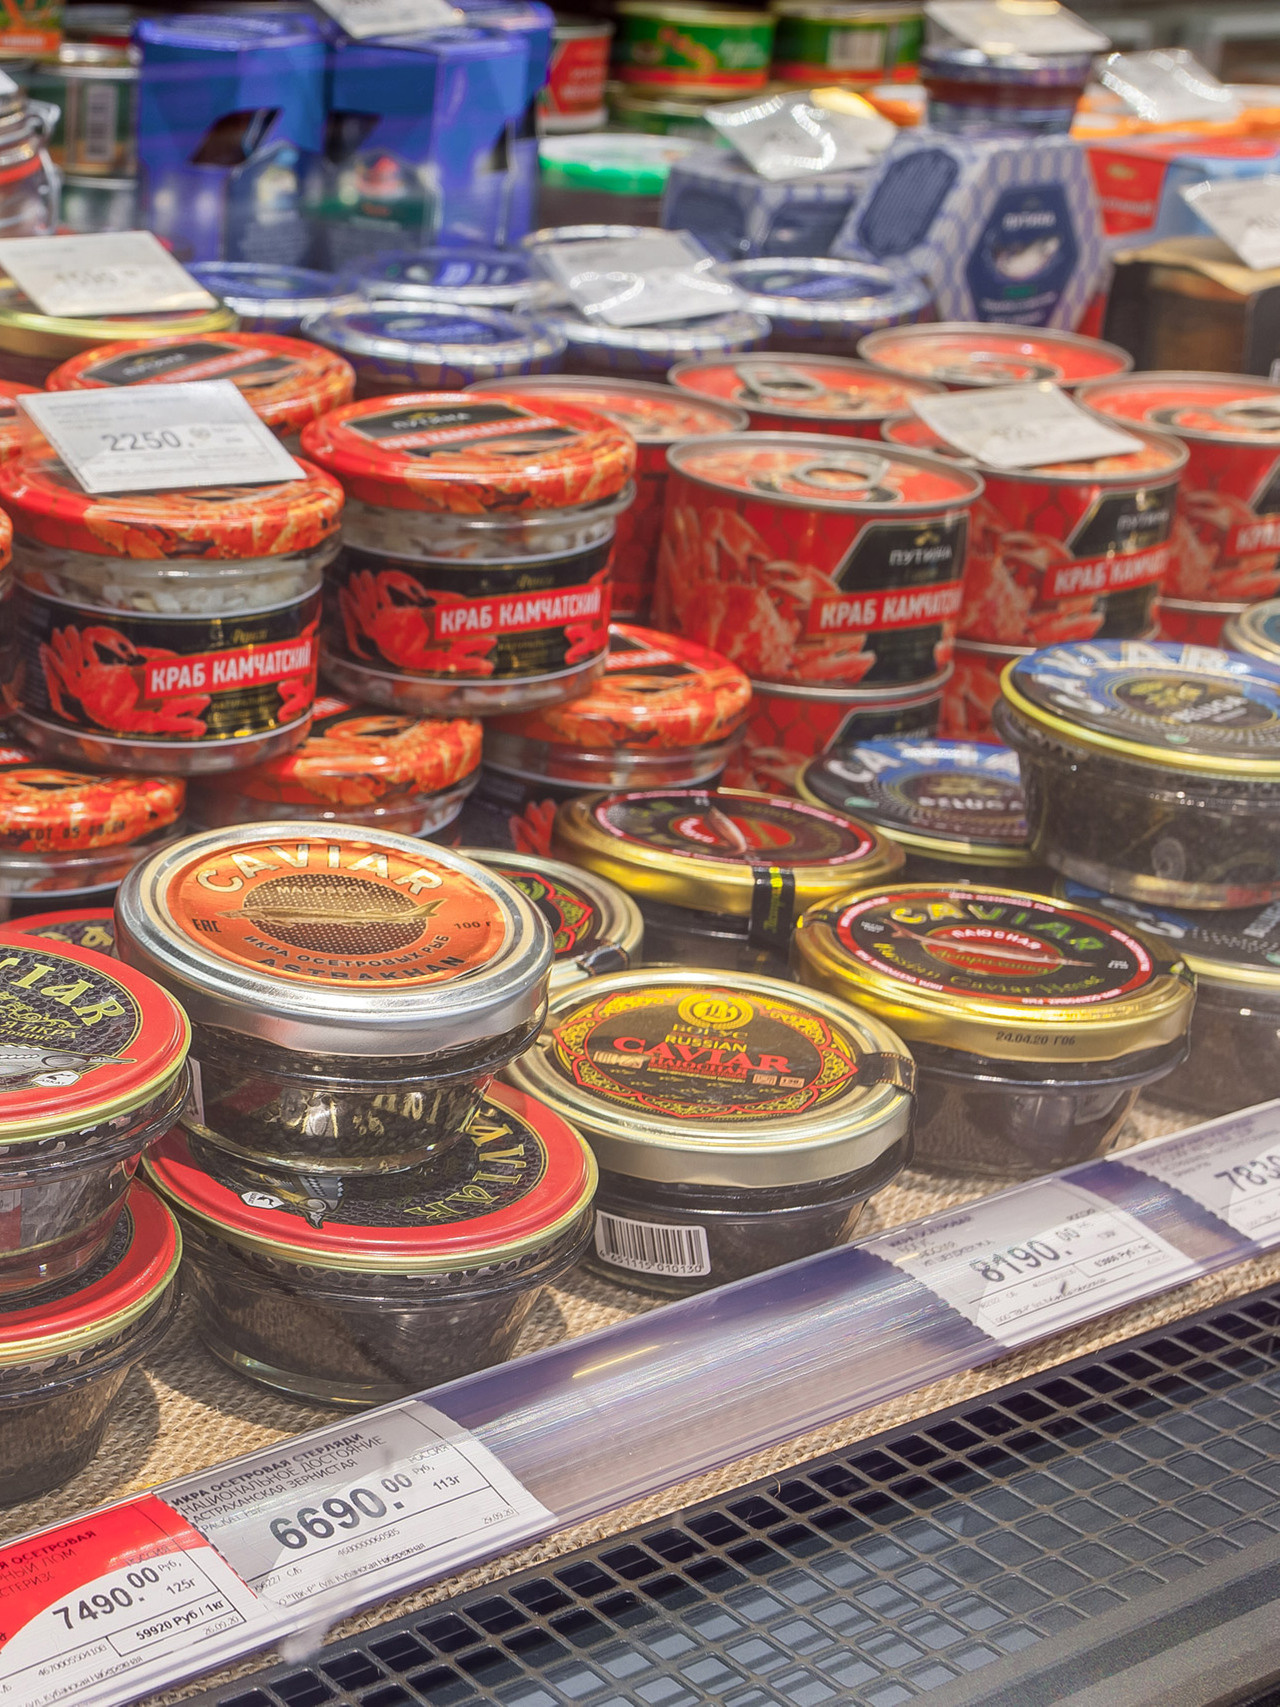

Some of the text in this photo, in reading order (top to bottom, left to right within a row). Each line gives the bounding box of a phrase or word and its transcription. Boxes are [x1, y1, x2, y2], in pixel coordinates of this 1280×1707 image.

[440, 605, 493, 633] КРАБ
[821, 600, 877, 629] КРАБ
[151, 641, 312, 693] КРАБ КАМЧАТСКИЙ
[196, 844, 445, 896] CAVIAR
[275, 884, 371, 896] MALOSSOL
[890, 902, 1105, 952] CAVIAR
[243, 934, 451, 969] ИКРА ОСЕТРОВЫХ РЫБ
[257, 955, 467, 982] ASTRAKHAN
[20, 1022, 77, 1039] ИКРА
[665, 1034, 748, 1053] RUSSIAN
[613, 1037, 792, 1074] CAVIAR
[171, 1433, 364, 1506] ИКРА ОСЕТРОВАЯ СТЕРЛЯДИ
[181, 1434, 387, 1516] НАЦИОНАЛЬНОЕ ДОСТОЯНИЕ
[431, 1474, 462, 1492] 113г
[193, 1458, 358, 1524] АСТРАХАНСКАЯ ЗЕРНИСТАЯ
[11, 1530, 98, 1563] ОСЕТРОВАЯ
[166, 1578, 196, 1596] 125г
[136, 1620, 173, 1642] 59920
[173, 1610, 198, 1628] Руб
[205, 1600, 225, 1614] 1кг
